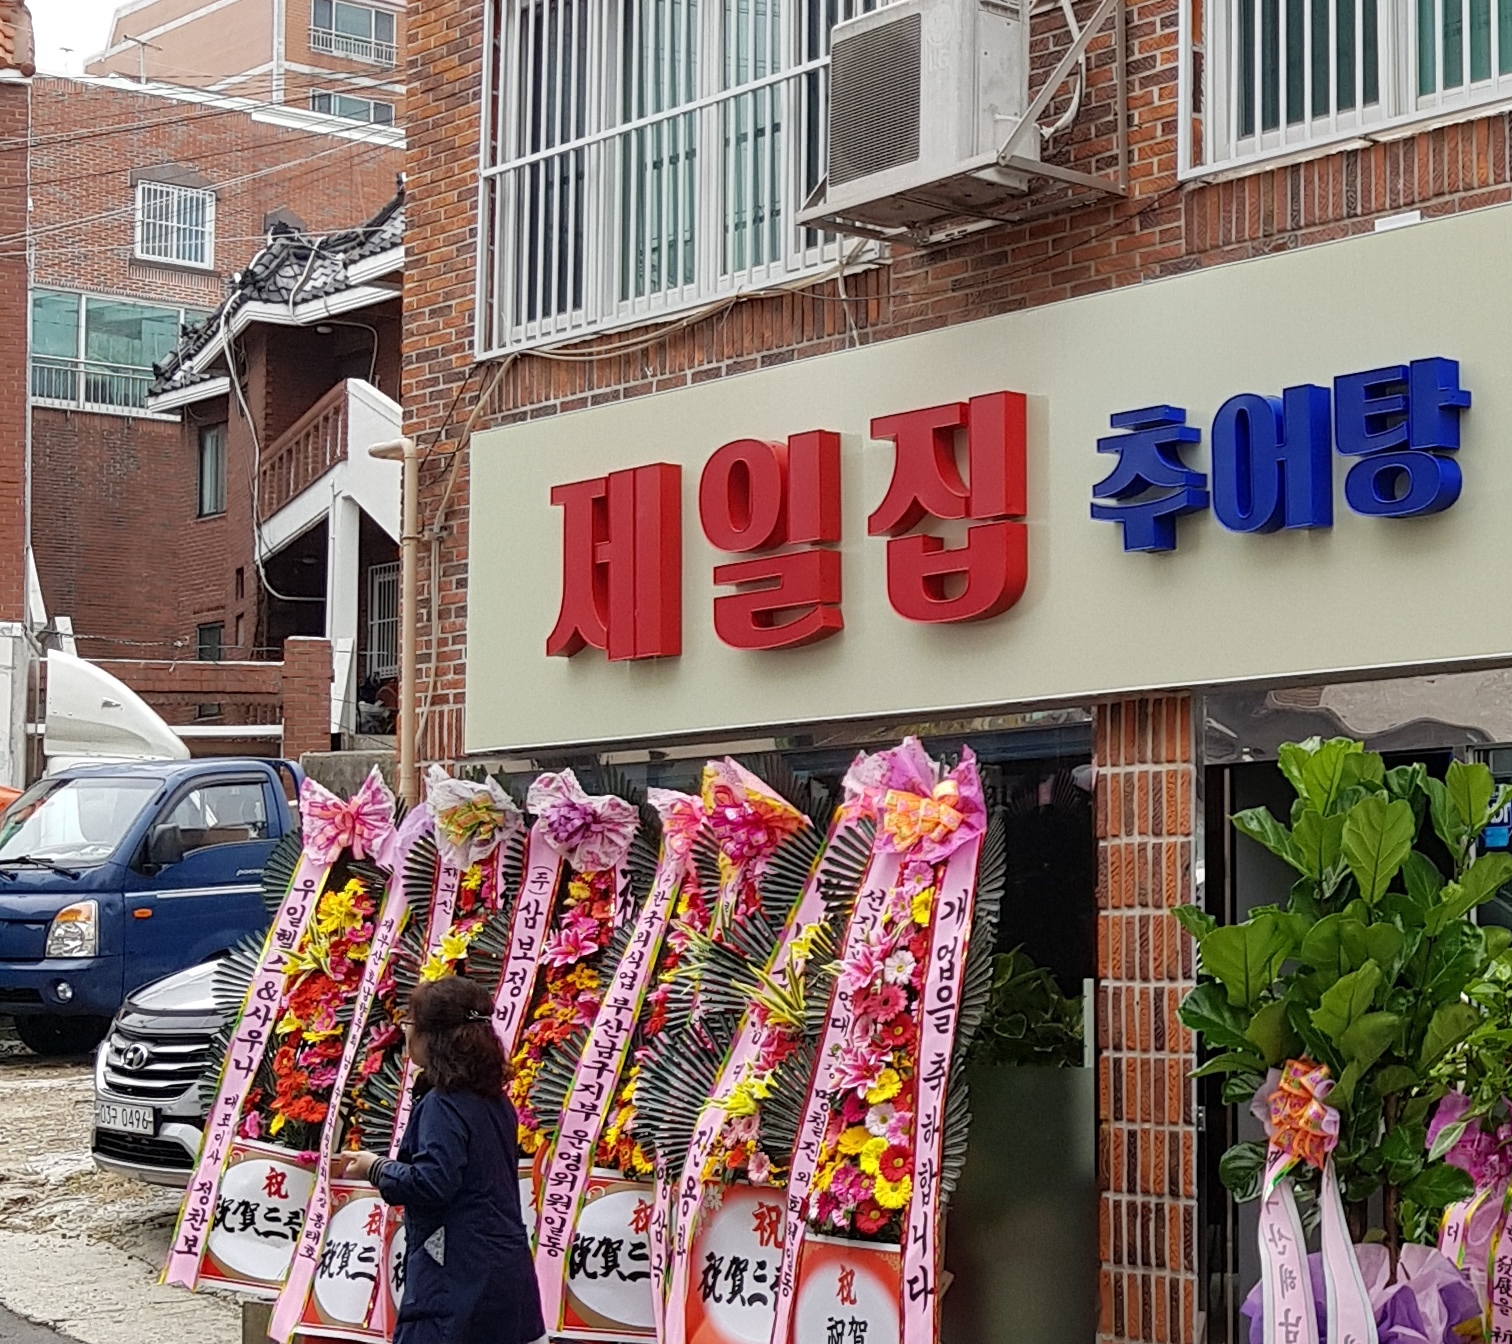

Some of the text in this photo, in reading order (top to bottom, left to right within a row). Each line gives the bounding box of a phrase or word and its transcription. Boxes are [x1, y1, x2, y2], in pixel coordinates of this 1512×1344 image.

[547, 356, 1471, 661] 제일집 추어탕
[496, 865, 554, 1033] (주)삼보정비
[568, 996, 633, 1123] 부산남구지부
[207, 1094, 240, 1166] 대표이사
[906, 897, 967, 1313] 개업을 축하합니다
[262, 1167, 290, 1199] 祝
[539, 1129, 592, 1258] 운영위원일동
[795, 1171, 811, 1188] 외
[174, 1181, 213, 1257] 정찬보
[752, 1202, 784, 1248] 祝
[836, 1264, 857, 1306] 祝
